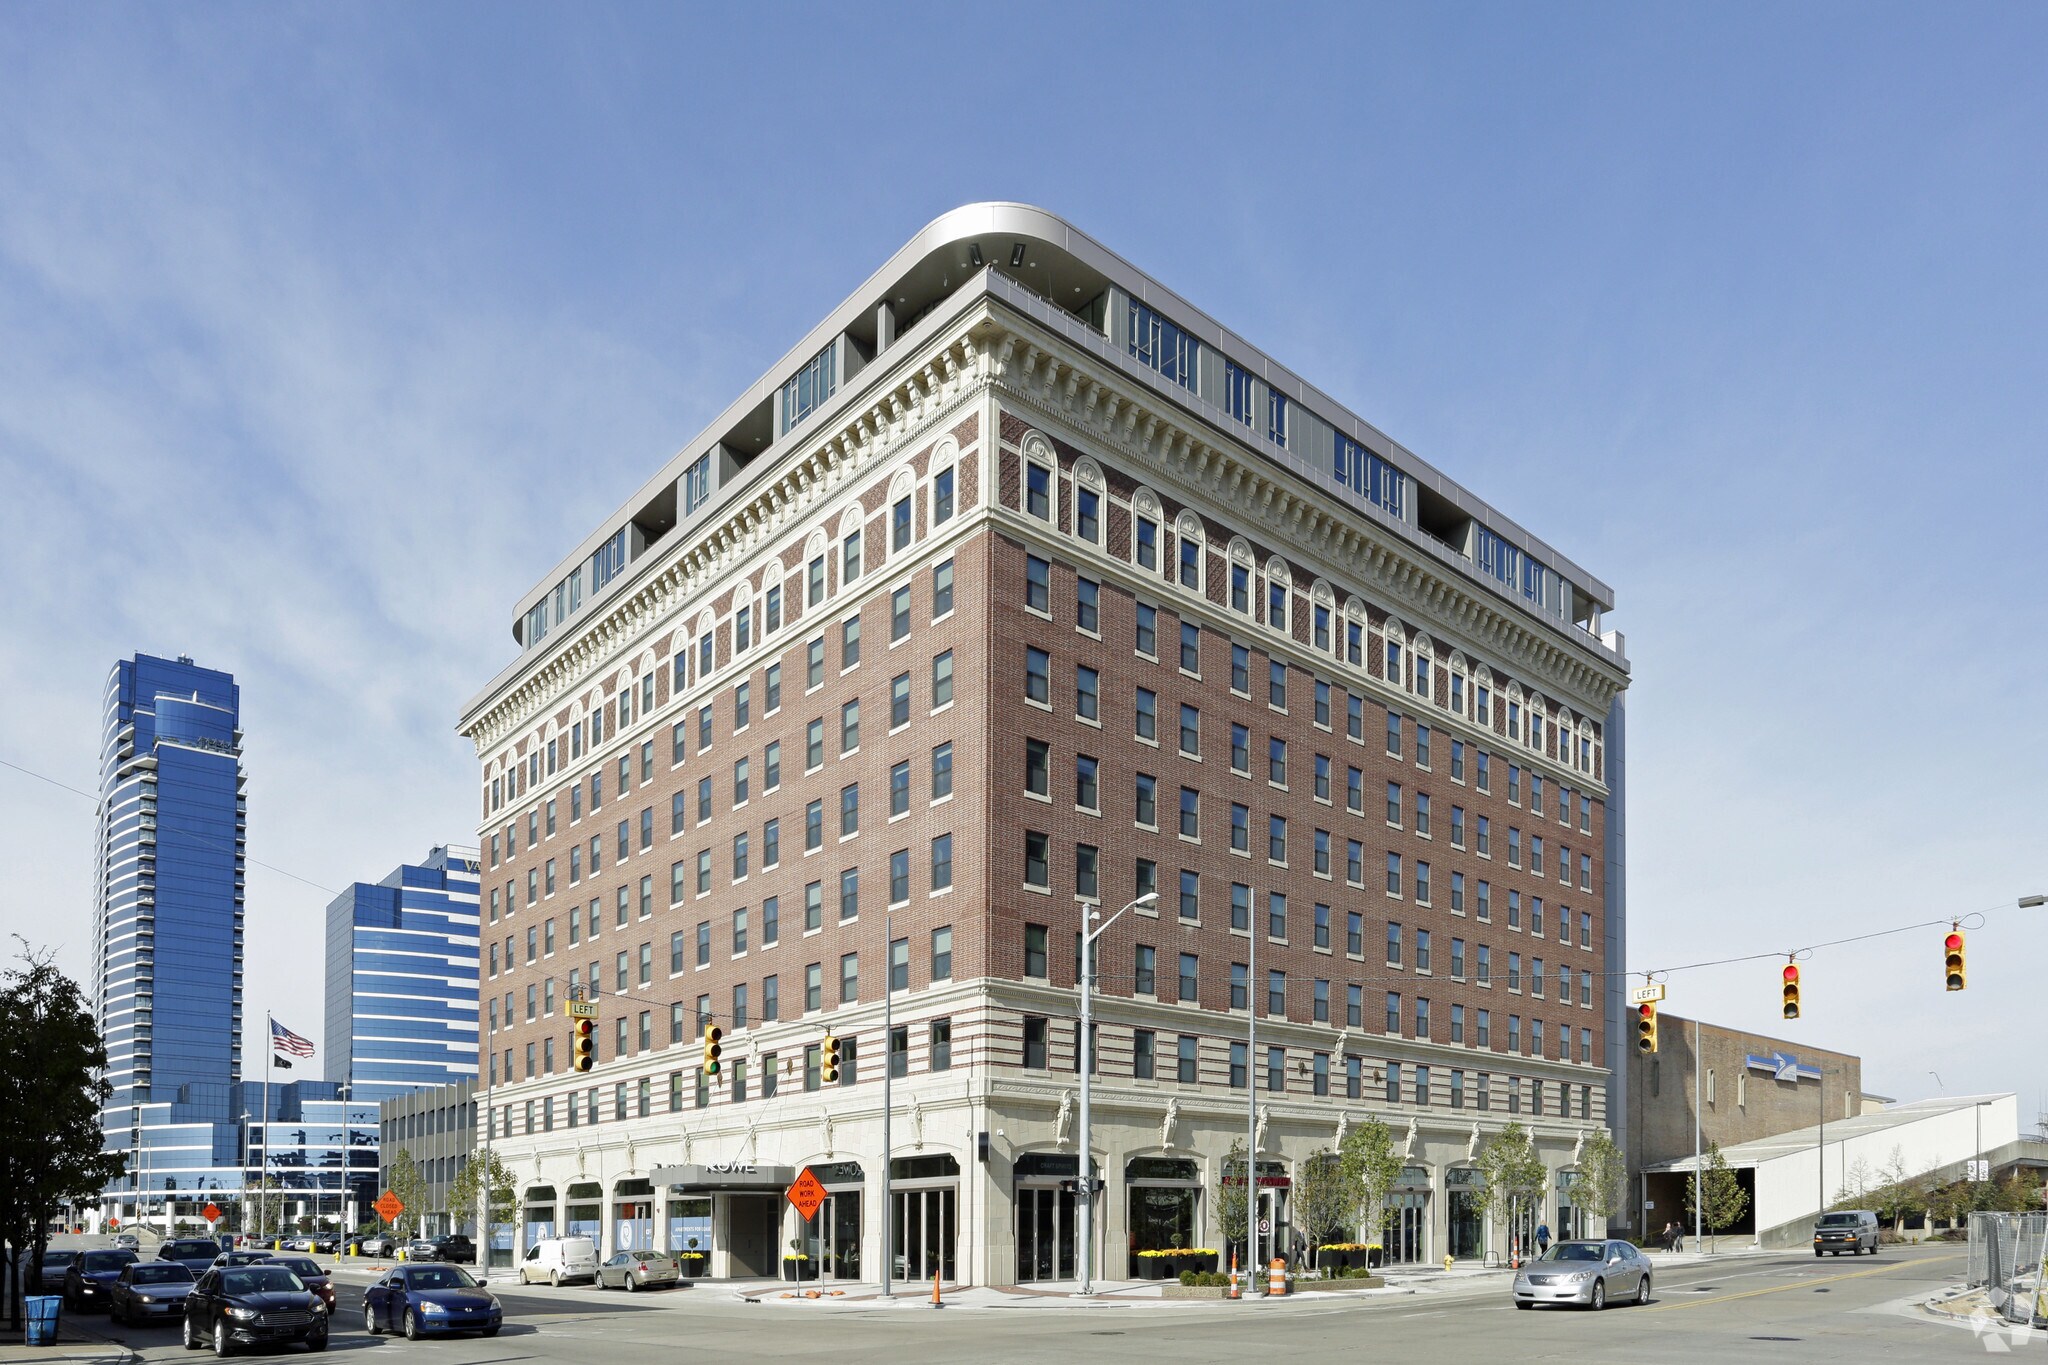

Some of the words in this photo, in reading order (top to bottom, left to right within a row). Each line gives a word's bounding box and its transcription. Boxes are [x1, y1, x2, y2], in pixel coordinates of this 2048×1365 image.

[1637, 988, 1656, 1000] LEFT
[574, 1004, 593, 1015] LEFT
[705, 1158, 755, 1172] ROWE
[799, 1180, 814, 1188] ROAD
[799, 1190, 815, 1198] WORK
[798, 1200, 817, 1208] AHEAD
